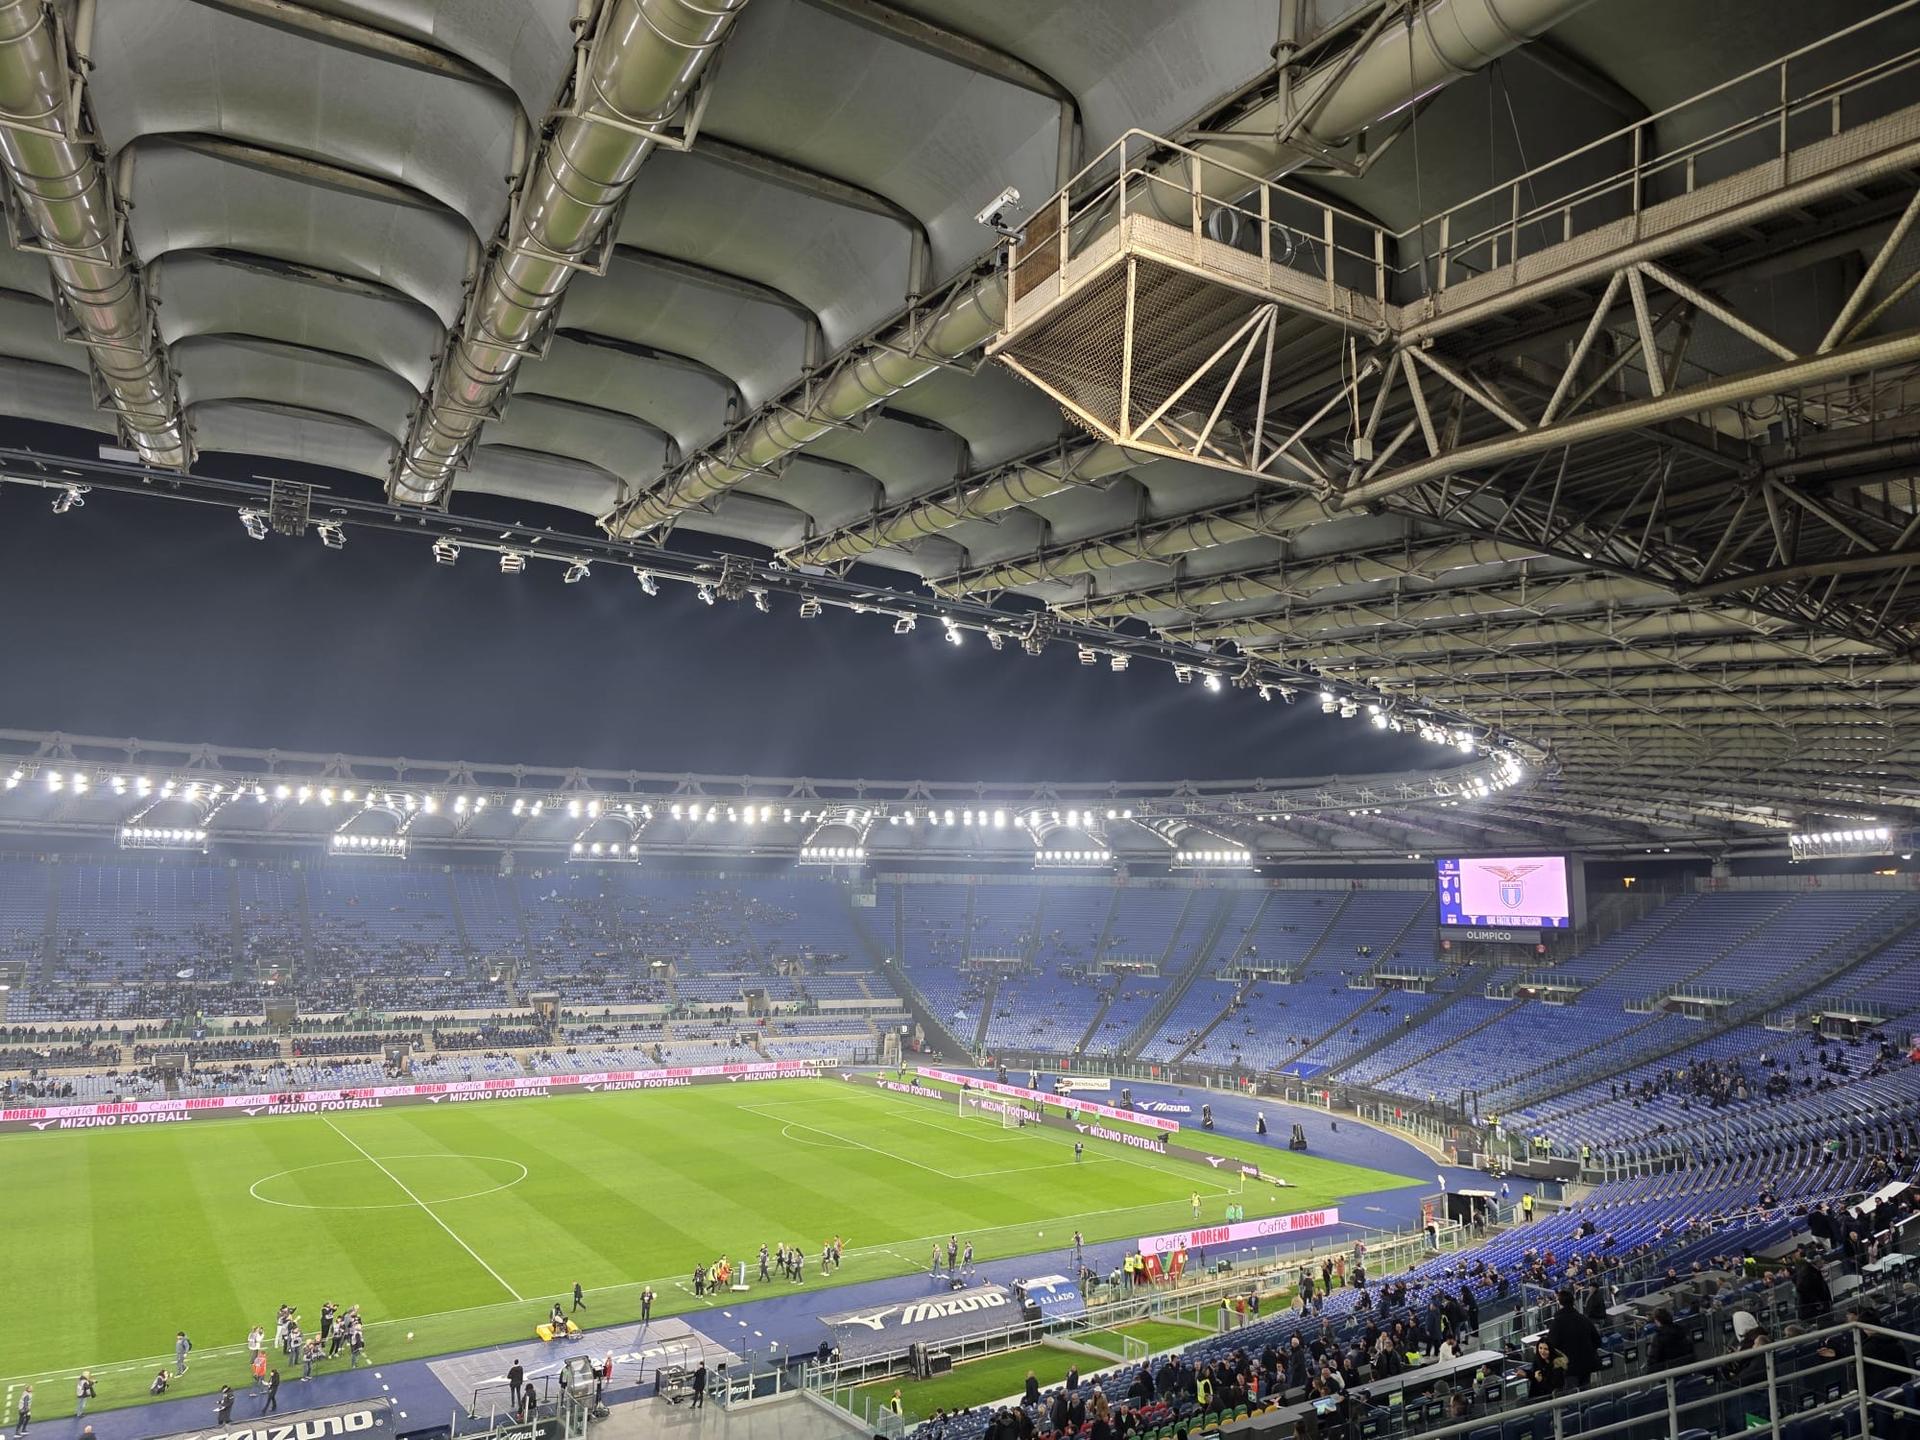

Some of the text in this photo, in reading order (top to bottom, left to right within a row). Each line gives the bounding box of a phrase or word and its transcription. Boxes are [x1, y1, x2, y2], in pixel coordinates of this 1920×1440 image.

[1466, 931, 1512, 941] OLIMPICO
[604, 1077, 691, 1091] MIZUNO FOOTBALL
[744, 1070, 778, 1081] MIZUNO
[3, 1108, 47, 1120] MORENO
[97, 1103, 138, 1114] MORENO
[185, 1098, 225, 1110] MORENO
[414, 1084, 447, 1094] MORENO
[484, 1080, 516, 1089] MORENO
[550, 1075, 580, 1085] MORENO
[450, 1087, 549, 1102] MIZUNO FOOTBALL
[887, 1081, 942, 1099] MIZUNO FOOTBALL
[269, 1099, 382, 1115] MIZUNO FOOTBALL
[60, 1111, 192, 1129] MIZUNO FOOTBALL
[1090, 1125, 1166, 1153] MIZUNO FOOTBALL
[1155, 1212, 1325, 1252] Caffè MORENO Caffè MORENO
[1053, 1292, 1075, 1302] LAZIO
[901, 1293, 1006, 1326] MIZUNO
